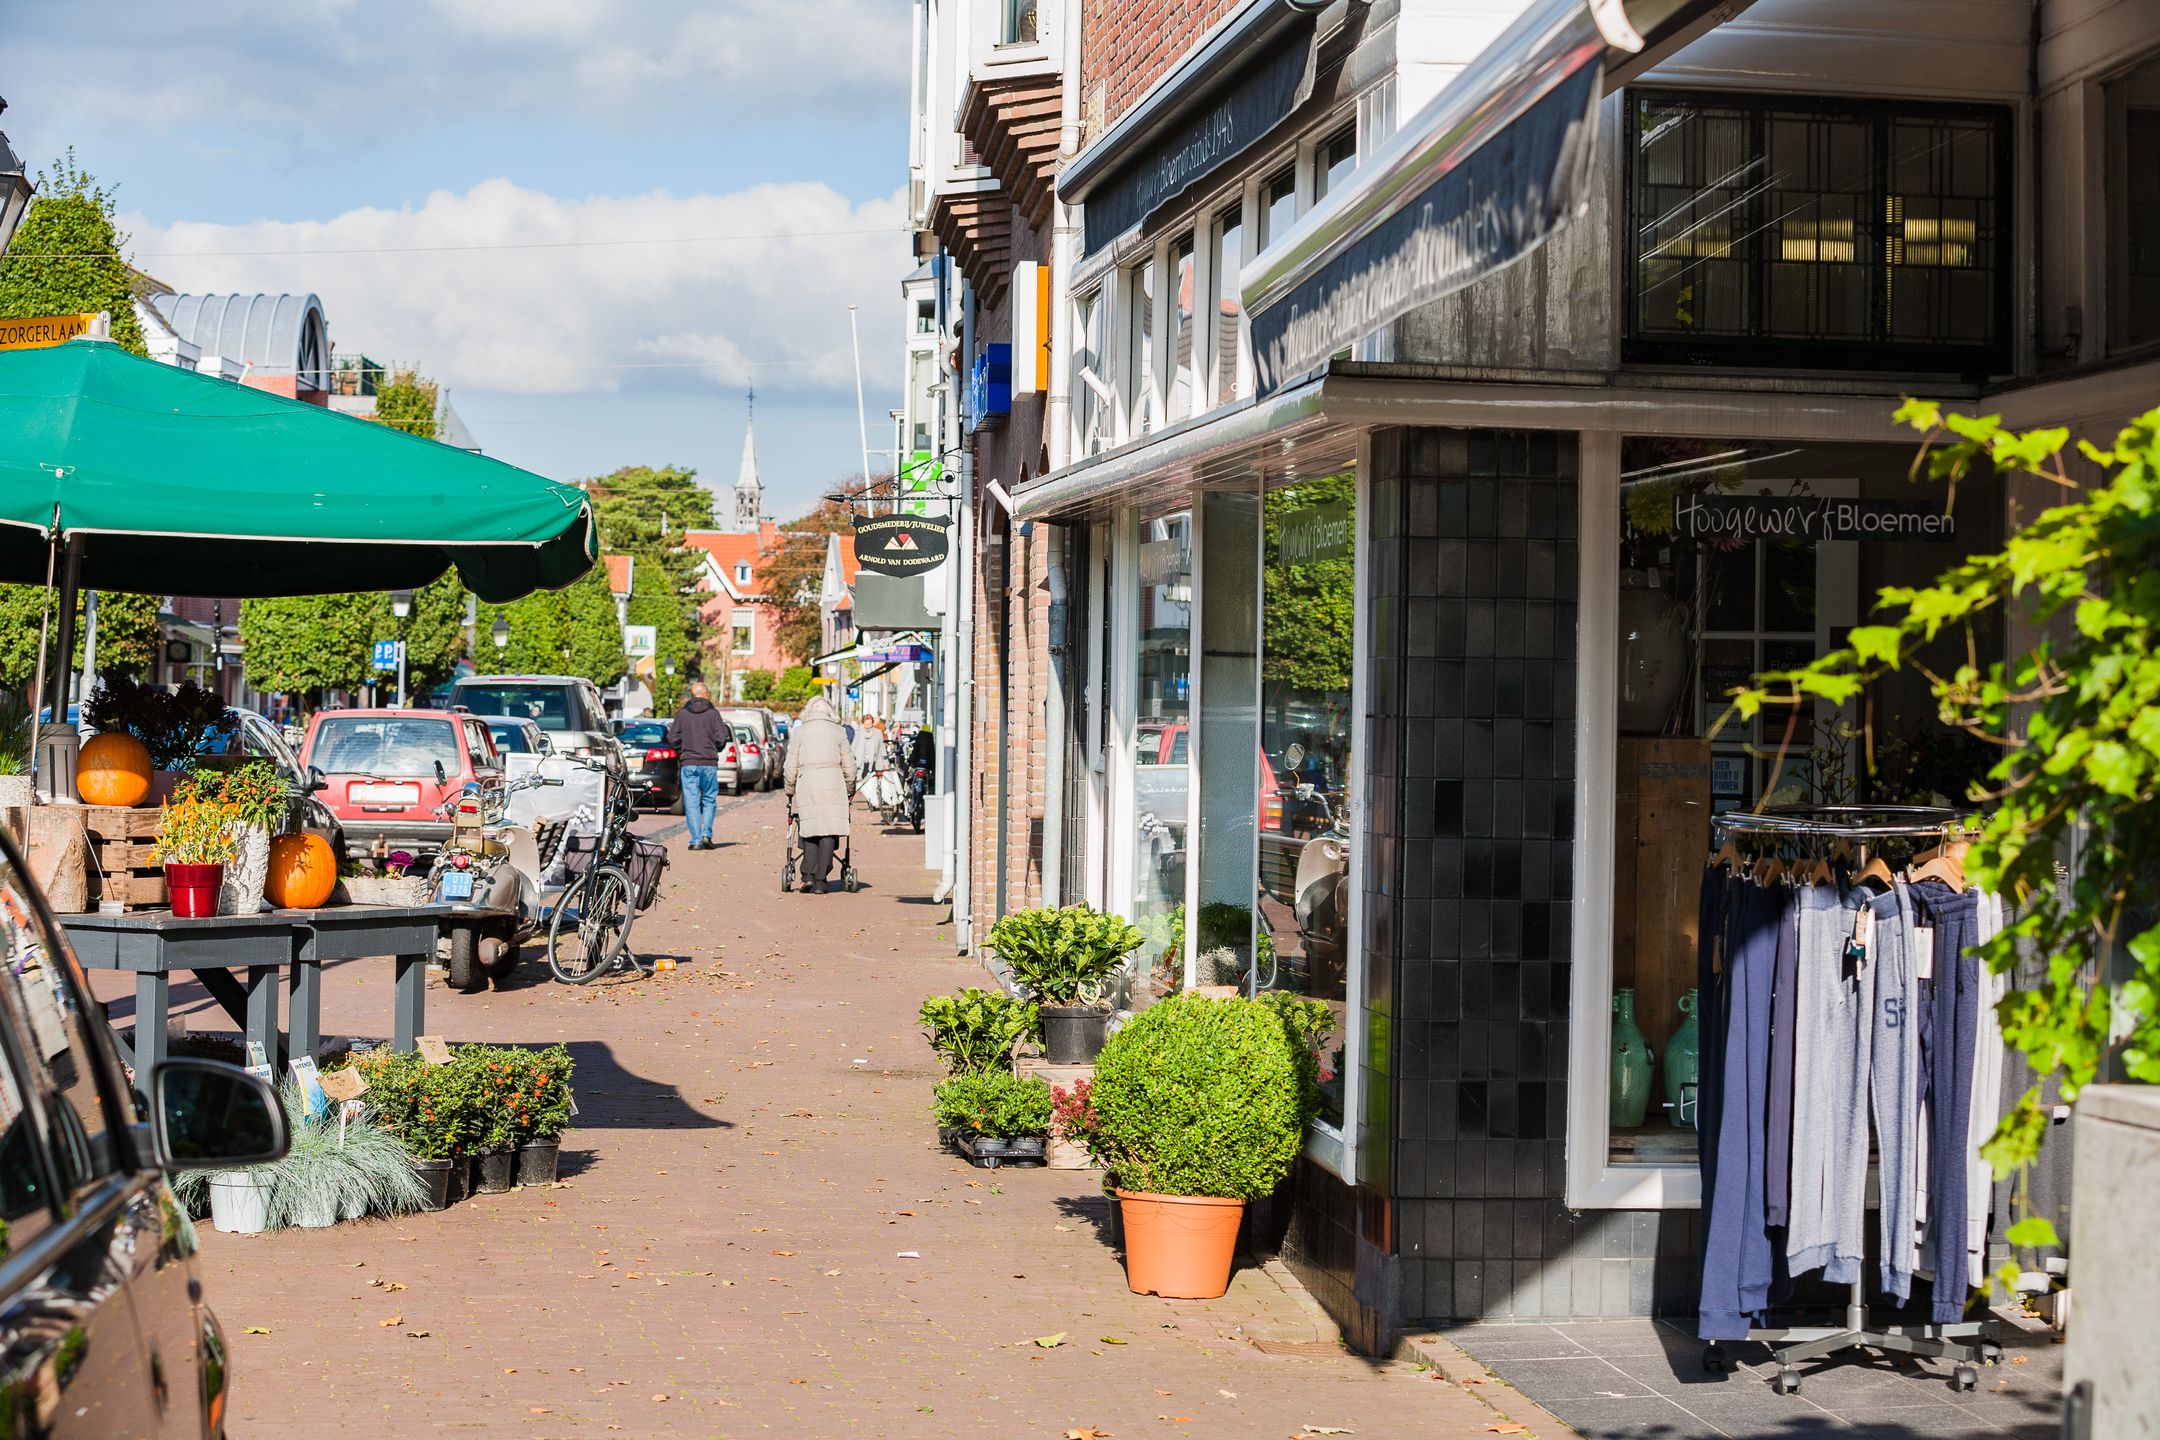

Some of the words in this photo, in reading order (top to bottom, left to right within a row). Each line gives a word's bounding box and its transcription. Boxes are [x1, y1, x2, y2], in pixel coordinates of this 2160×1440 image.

[1211, 97, 1235, 156] 1948
[857, 520, 946, 534] GOUDSMEDERIJ/JUWELIER
[1316, 514, 1348, 550] Bloemen
[1675, 493, 1835, 541] Hoogewerf
[1837, 504, 1955, 534] Bloemen
[858, 553, 887, 565] ARNOLD
[887, 558, 901, 566] VAN
[902, 553, 945, 566] DODEWAARD
